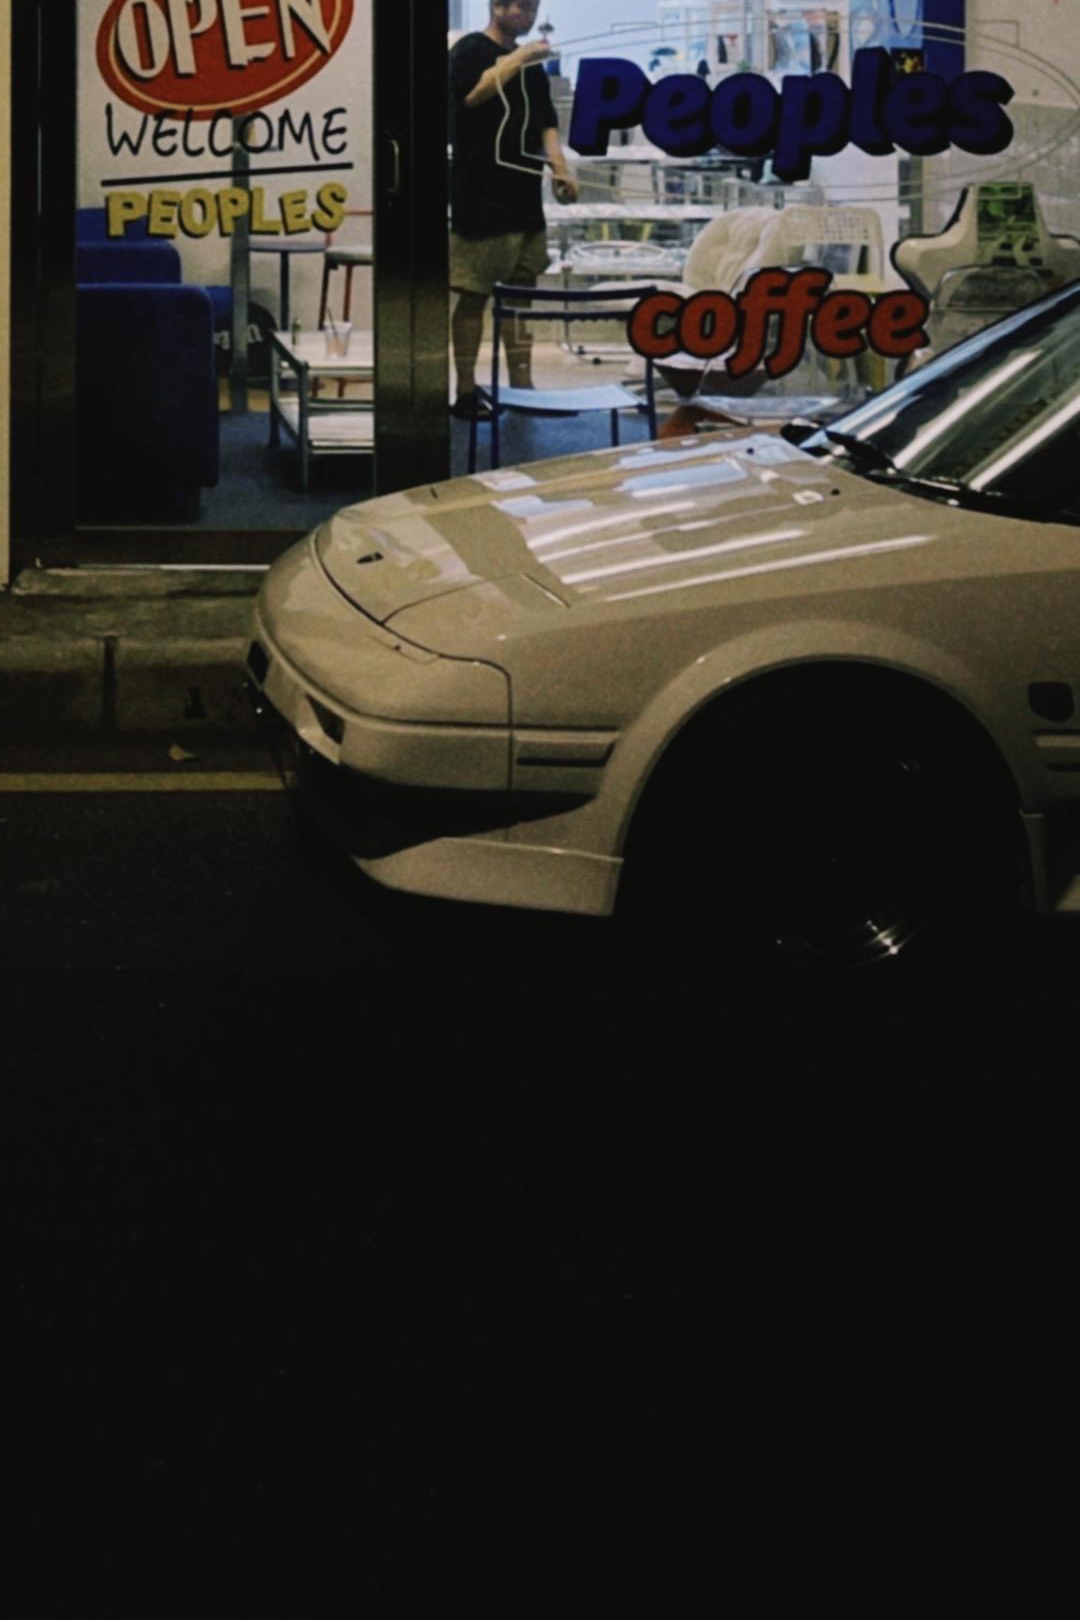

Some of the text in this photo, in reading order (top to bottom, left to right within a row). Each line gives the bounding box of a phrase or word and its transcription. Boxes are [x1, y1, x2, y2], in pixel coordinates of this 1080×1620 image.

[104, 106, 348, 162] WELCOME
[568, 47, 1015, 182] Peoples
[104, 182, 349, 240] PEOPLES
[627, 265, 931, 380] coffee
